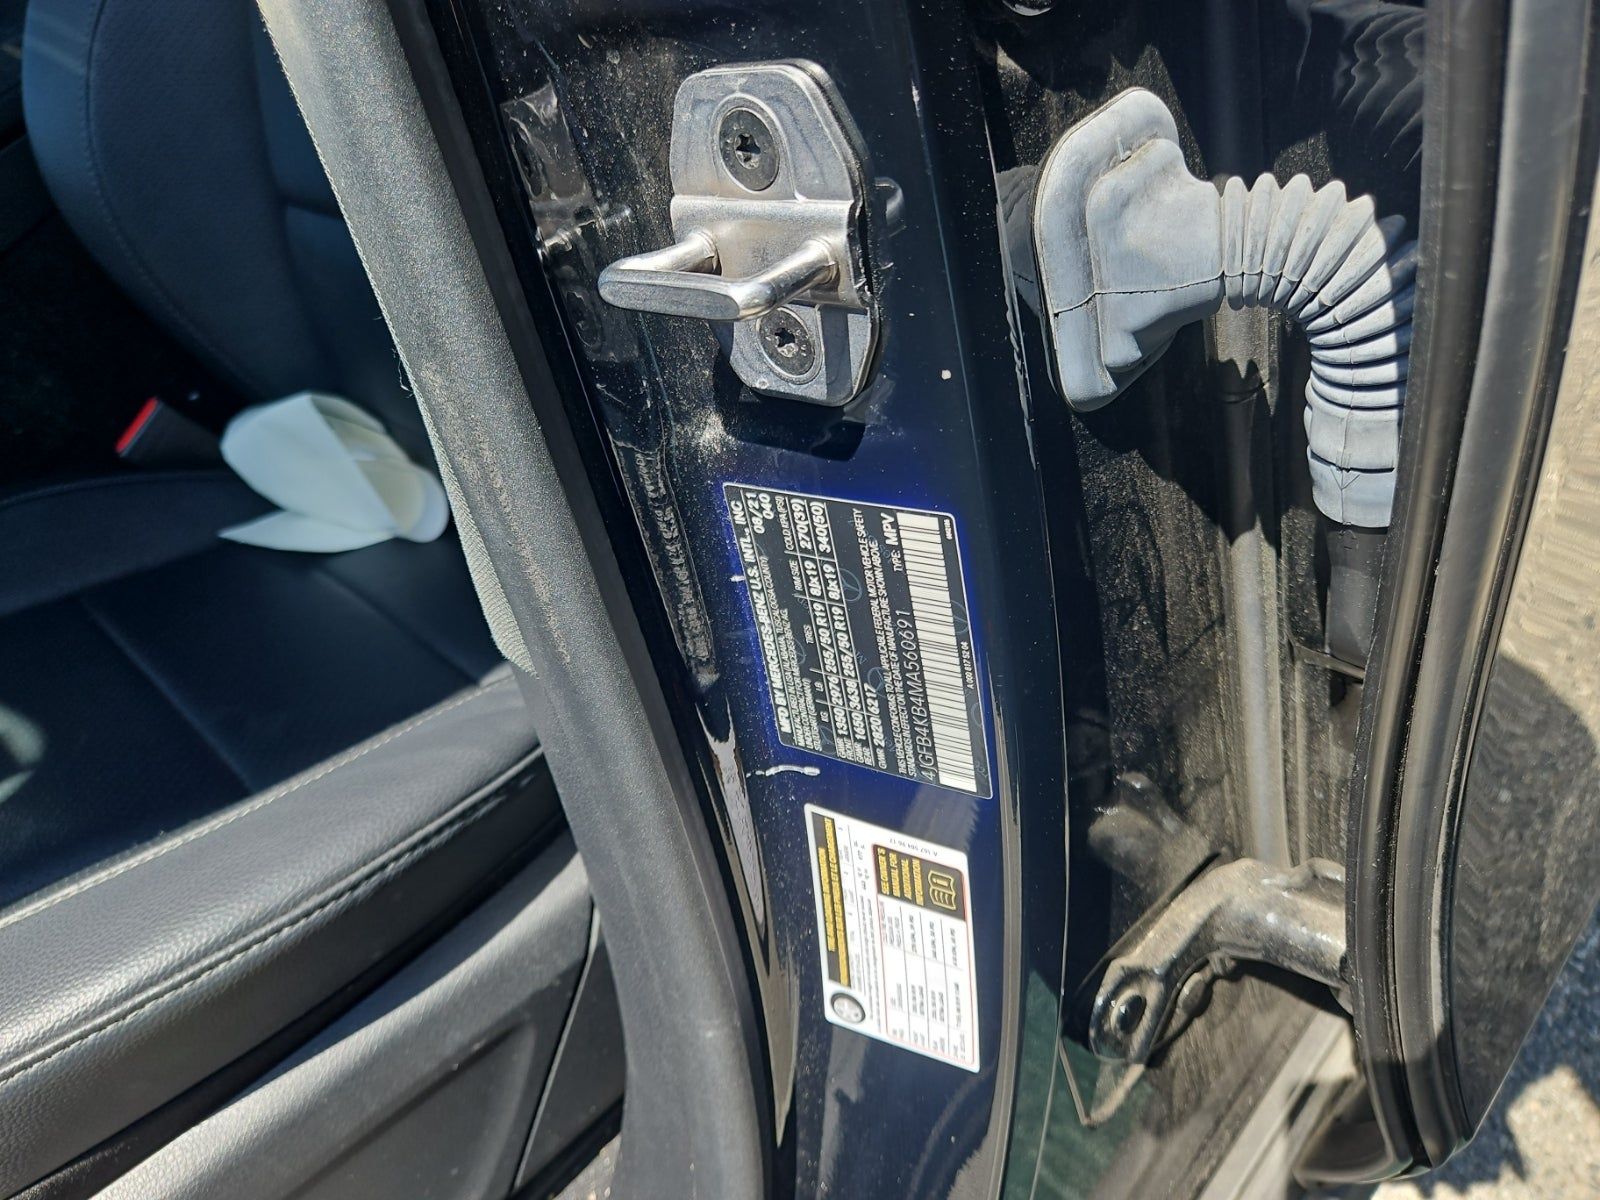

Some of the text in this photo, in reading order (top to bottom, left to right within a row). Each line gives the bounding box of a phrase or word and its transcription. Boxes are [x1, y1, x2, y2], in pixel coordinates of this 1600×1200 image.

[730, 500, 746, 525] INC
[745, 492, 765, 534] 08/21
[758, 493, 774, 519] 040
[774, 495, 794, 550] COLD KPA (PSI)
[880, 513, 903, 571] TYPE: MPV
[747, 565, 762, 590] U.S.
[789, 560, 803, 591] RIM SIZE
[874, 567, 887, 597] SHOWN
[767, 589, 783, 633] TUSCALOOSA
[790, 498, 848, 735] 1350 2976 255/50 R19 8Jx19 270(39)
[810, 501, 866, 740] 1650 3638 255/50 R19 8Jx19 340(50)
[879, 597, 896, 651] MANUFACTURE
[753, 591, 783, 688] MERCEDES-BENZ
[782, 620, 800, 676] MERCEDES-BENZ
[803, 624, 814, 644] TIRES
[852, 508, 907, 774] THIS VEHICLE CONFORMS TO ALL APPLICABLE FEDERAL MOTOR VEHICLE SAFETY
[888, 650, 899, 662] OF
[890, 661, 902, 680] DATE
[784, 671, 794, 686] USA
[788, 685, 795, 694] IN
[793, 676, 803, 690] FOR
[893, 680, 904, 693] THE
[773, 689, 787, 706] BY
[796, 691, 809, 726] CONTRACT
[814, 681, 829, 722] KG LB
[863, 683, 880, 714] 6217
[896, 611, 937, 780] 4JGFB4KB4MA560691
[896, 693, 906, 705] ON
[777, 706, 791, 733] MFD
[789, 694, 805, 746] MANUFACTURED
[802, 678, 822, 751] STUTTGART (GERMANY)
[897, 705, 910, 730] EFFECT
[803, 725, 814, 749] UNDER
[870, 716, 885, 747] 2820
[902, 729, 911, 738] IN
[835, 737, 847, 758] GAWR
[843, 737, 855, 761] FRONT
[853, 742, 864, 763] GAWR
[862, 747, 872, 766] REAR
[903, 738, 917, 777] STANDARDS
[824, 817, 836, 863] CHARGEMENT
[829, 862, 838, 873] LE
[830, 871, 839, 882] ET
[889, 853, 901, 897] MANUAL FOR
[901, 859, 912, 899] ADDITIONAL
[912, 859, 924, 905] INFORMATION
[881, 881, 890, 895] SEE
